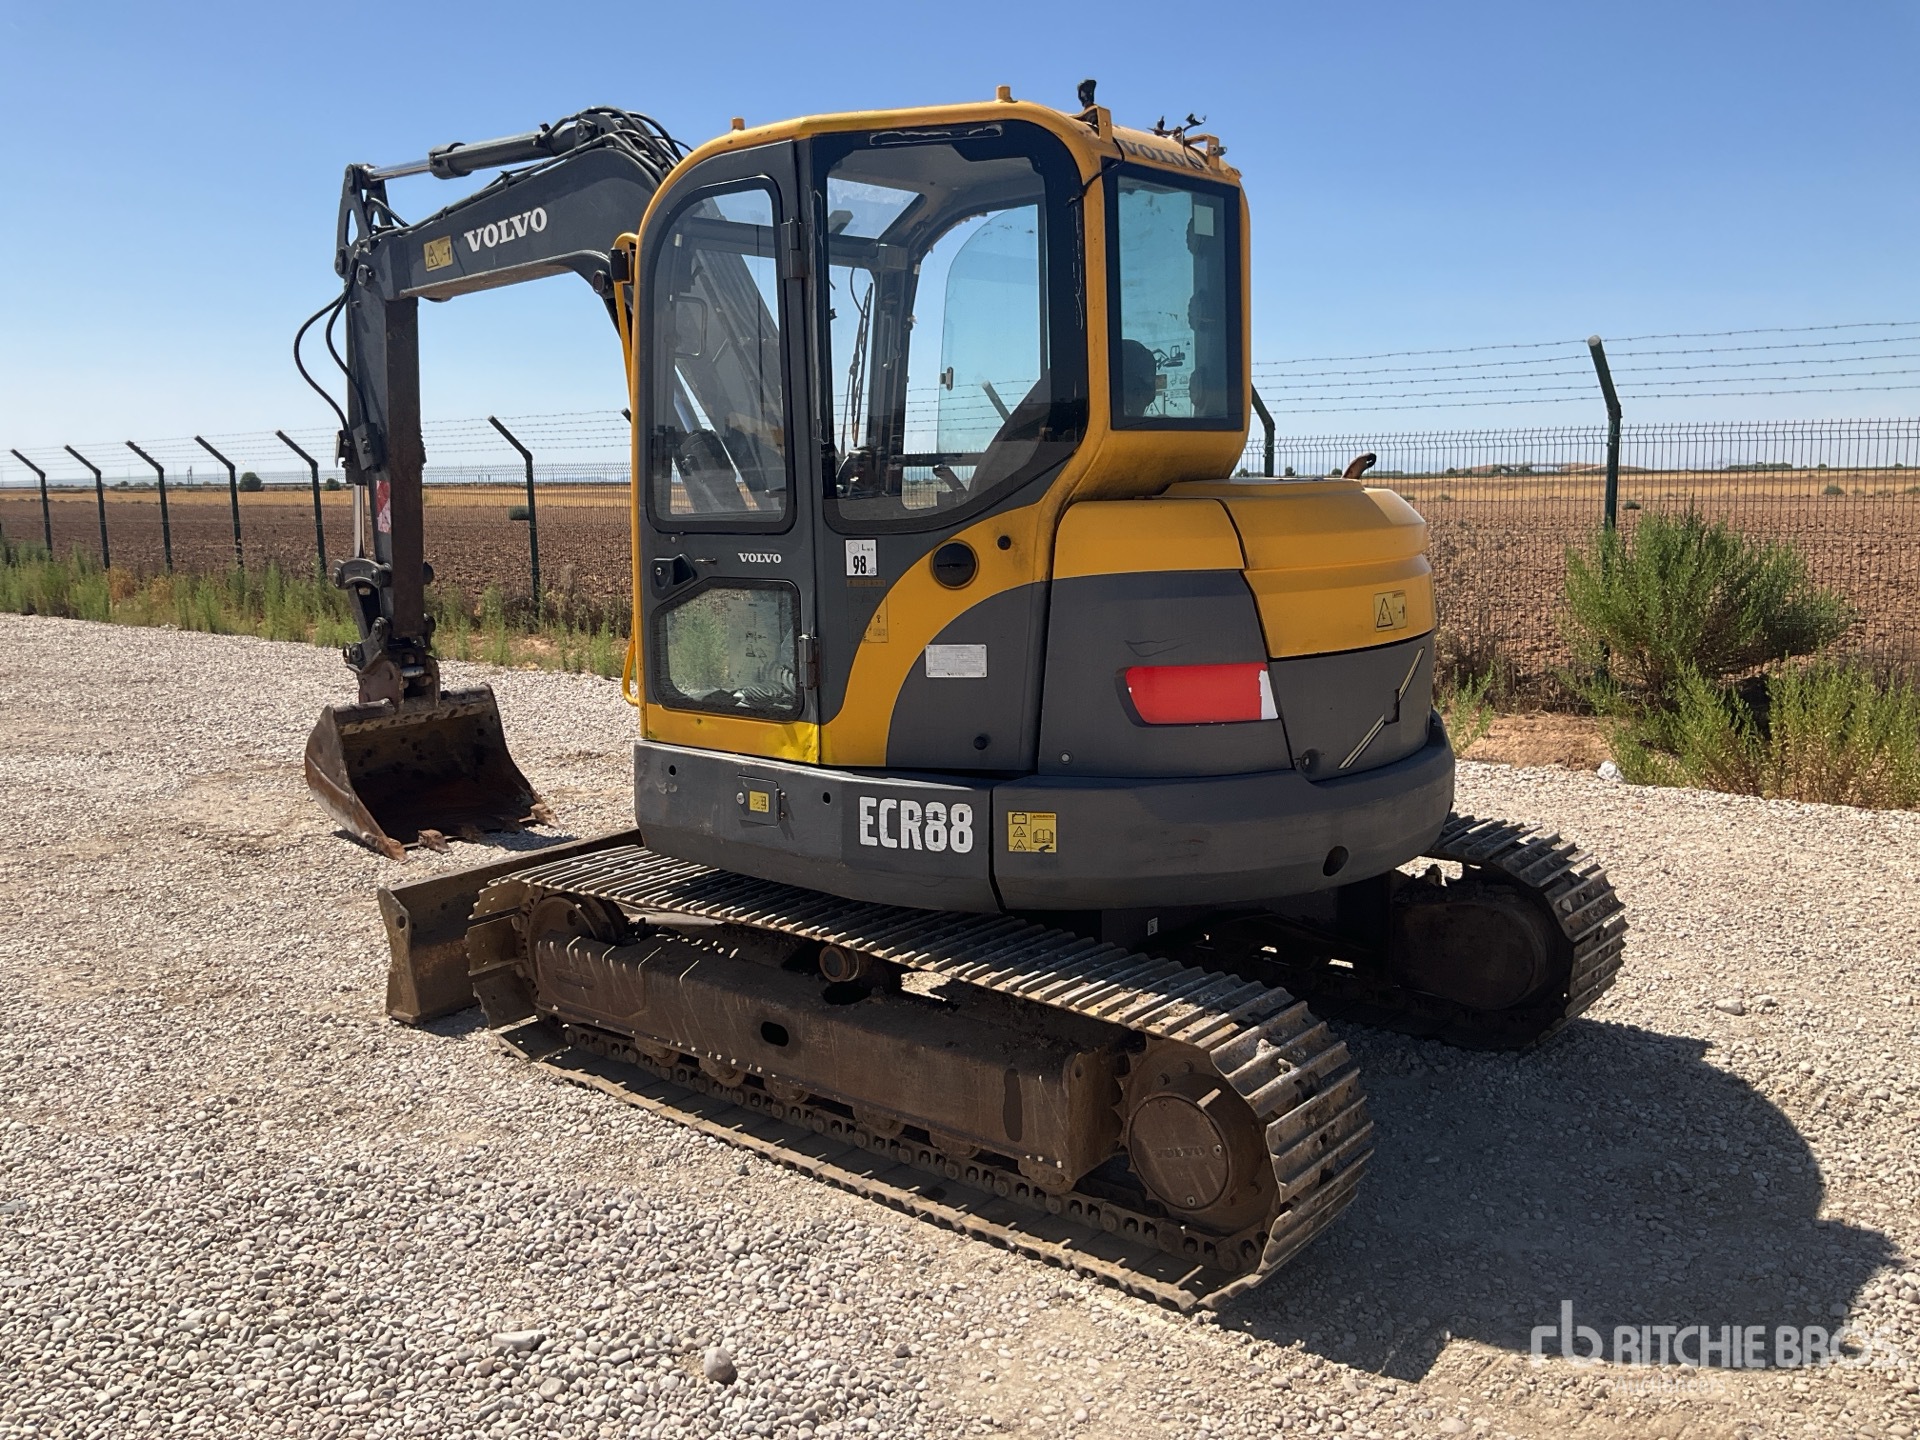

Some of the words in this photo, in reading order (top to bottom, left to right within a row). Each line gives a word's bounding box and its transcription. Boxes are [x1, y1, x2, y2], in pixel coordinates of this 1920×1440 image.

[1117, 138, 1205, 171] VOLVO
[464, 207, 548, 252] VOLVO
[738, 552, 782, 564] VOLVO
[853, 555, 867, 574] 98
[859, 796, 974, 853] ECR88
